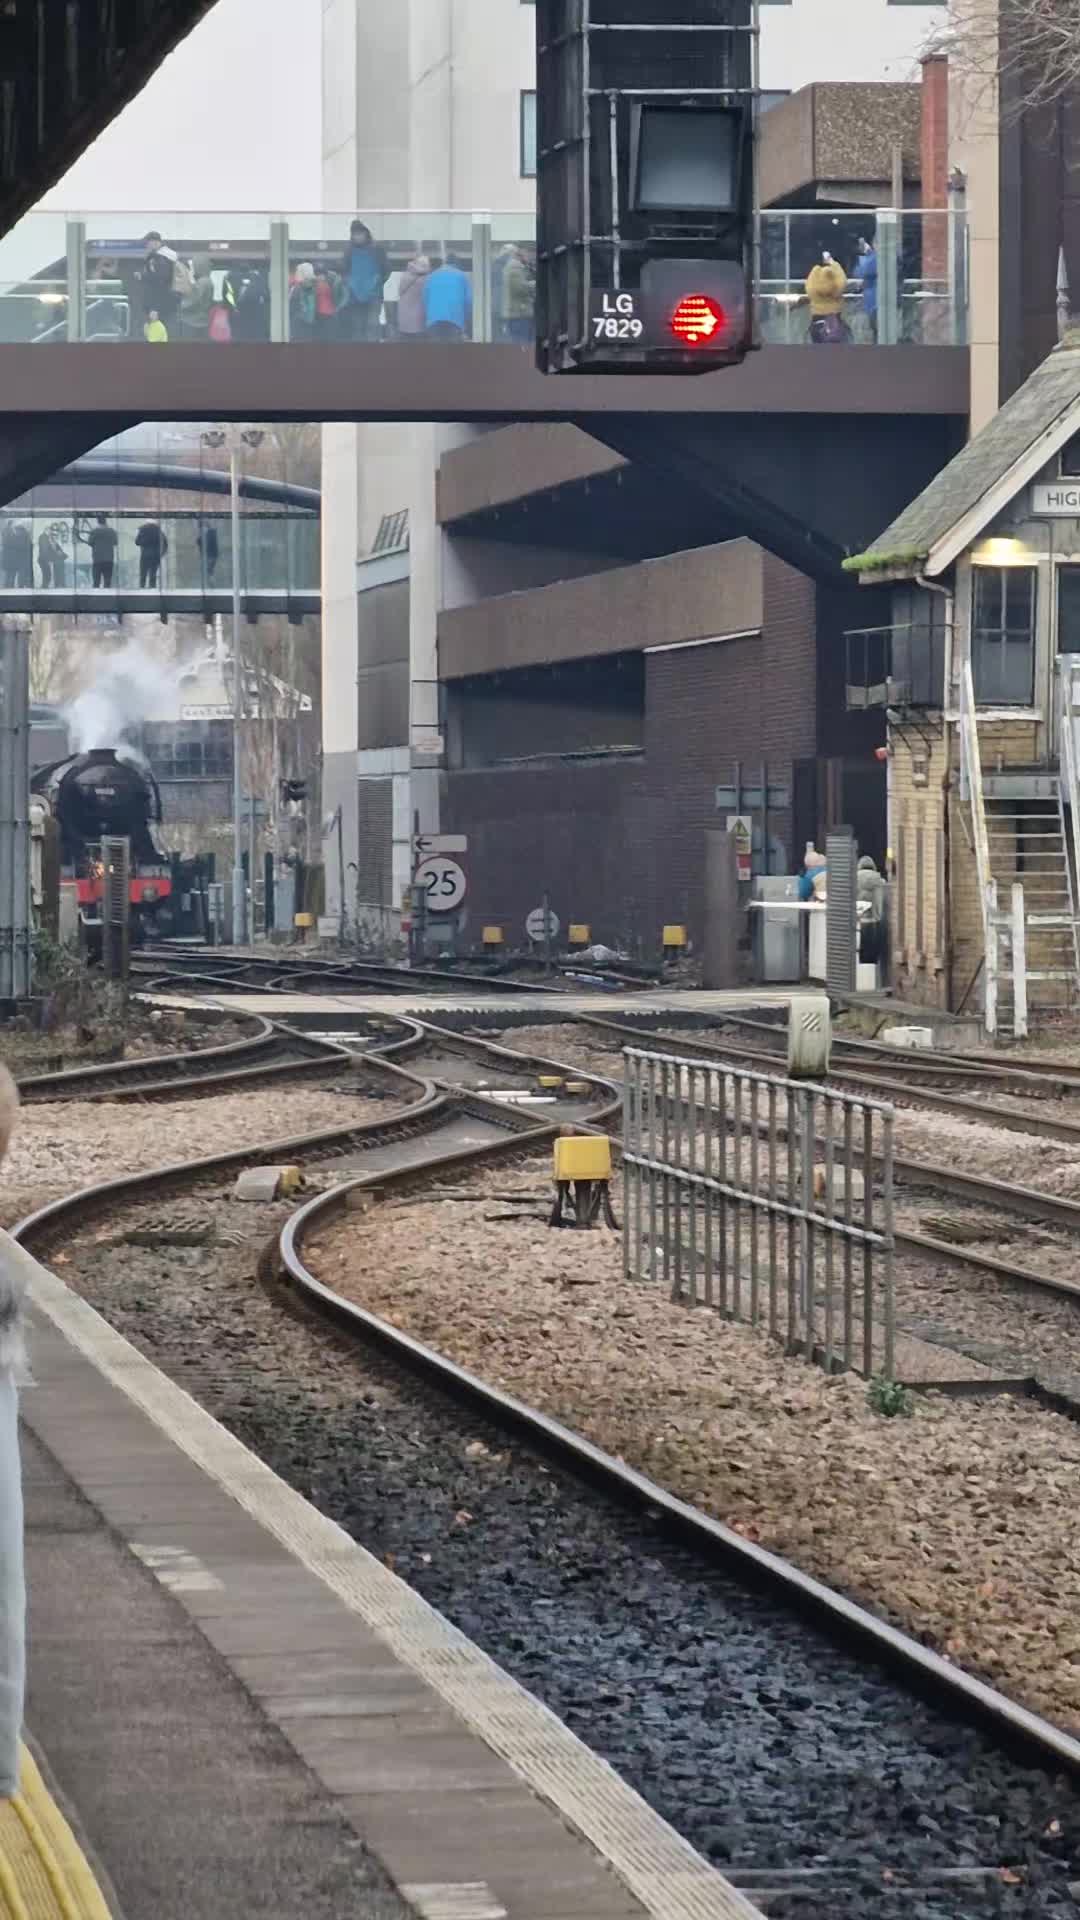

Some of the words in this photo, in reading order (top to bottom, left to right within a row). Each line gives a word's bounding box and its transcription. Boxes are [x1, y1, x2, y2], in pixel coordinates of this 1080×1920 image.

[602, 293, 633, 313] LG
[592, 317, 643, 338] 7829
[1047, 491, 1080, 506] HIG
[424, 870, 457, 897] 25
